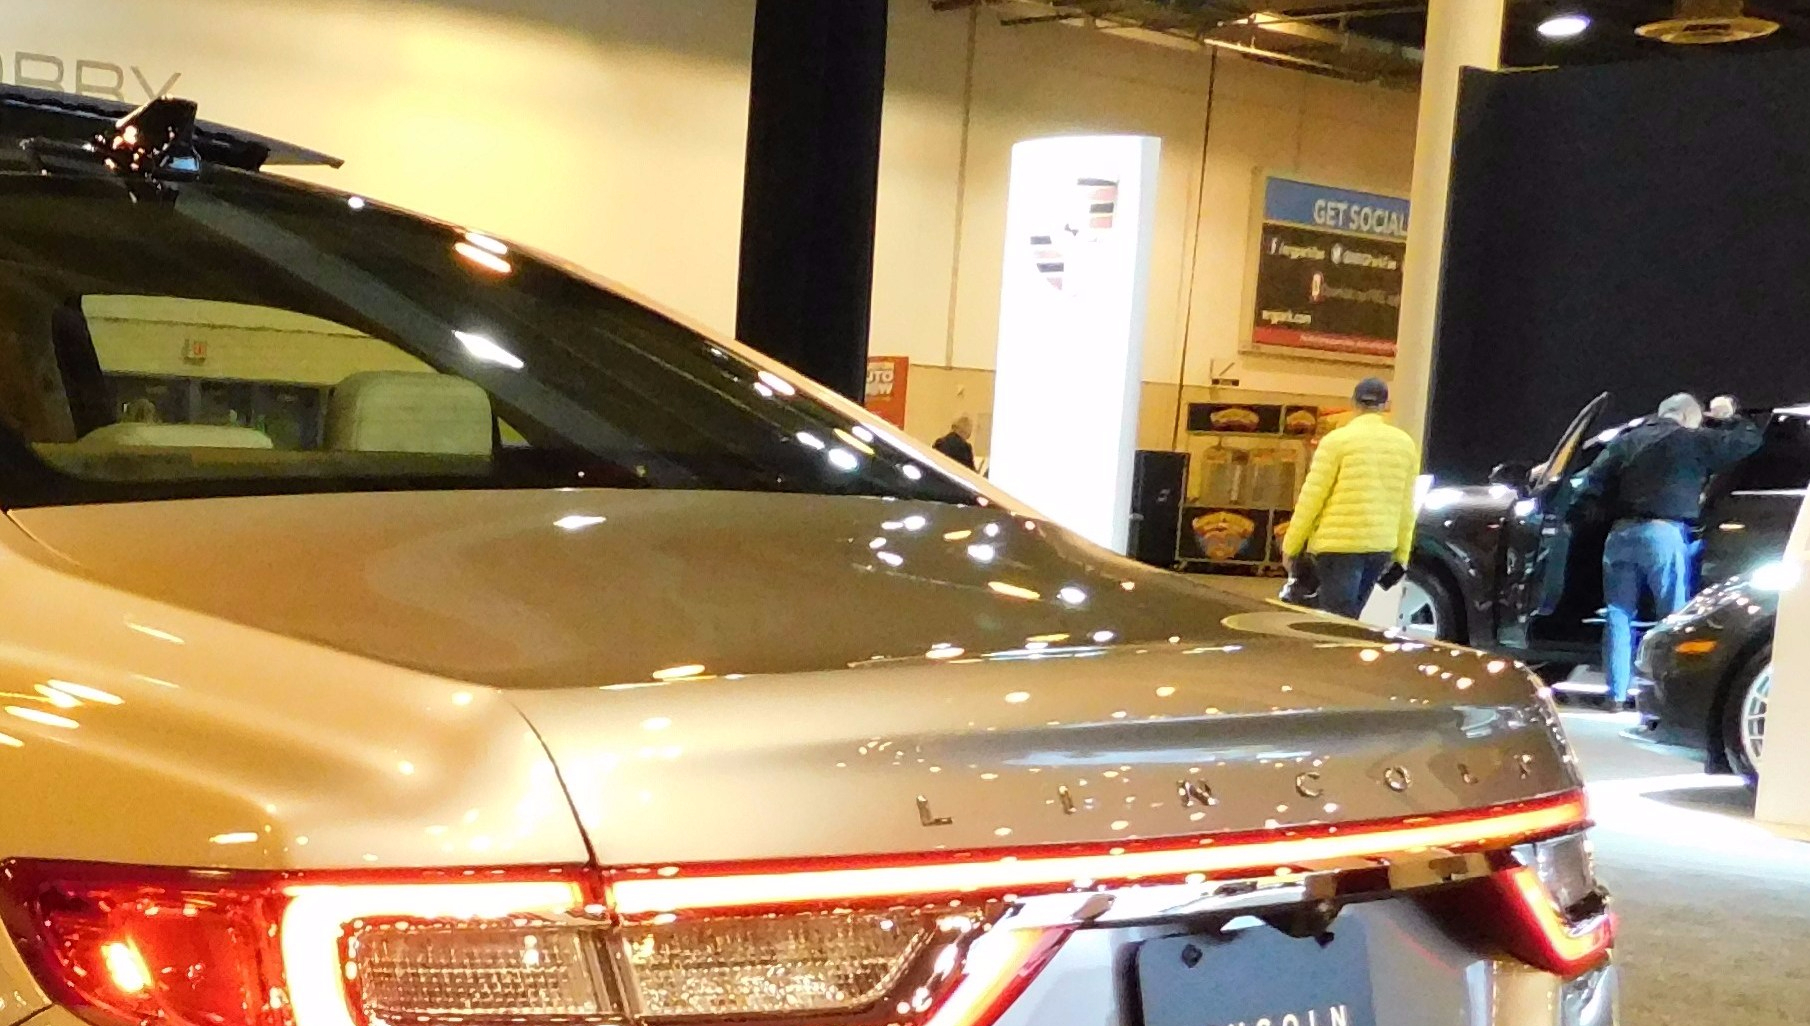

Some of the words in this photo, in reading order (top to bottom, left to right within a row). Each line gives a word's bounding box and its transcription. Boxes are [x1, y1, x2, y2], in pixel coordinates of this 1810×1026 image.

[1313, 198, 1349, 228] GET
[1349, 205, 1408, 236] SOCIAL
[866, 369, 895, 384] UTO
